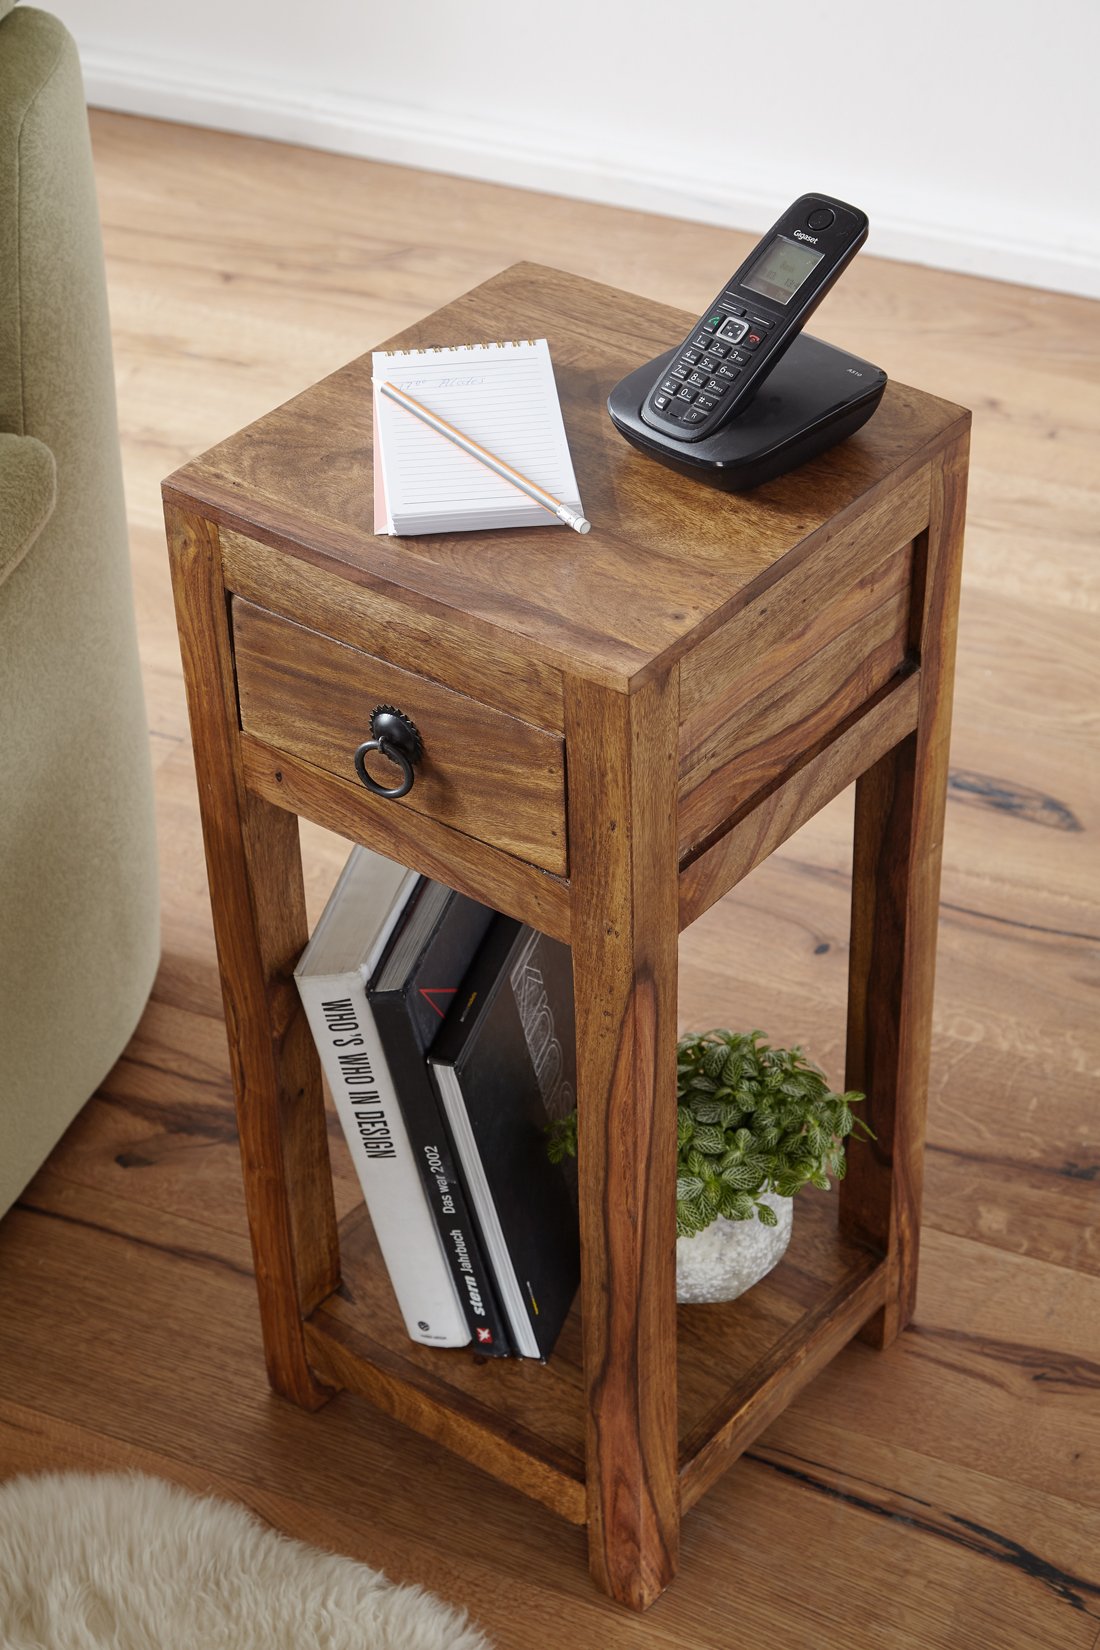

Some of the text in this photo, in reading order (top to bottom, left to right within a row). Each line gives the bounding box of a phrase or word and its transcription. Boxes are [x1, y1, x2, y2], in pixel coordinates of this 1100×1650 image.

[793, 229, 819, 245] Gigaset
[712, 343, 720, 351] 2
[730, 351, 739, 359] 3
[701, 358, 709, 366] 5
[720, 366, 728, 374] 6
[690, 373, 699, 381] 8
[708, 380, 716, 388] 9
[680, 388, 688, 396] 0
[321, 998, 397, 1159] WHO'S WHO IN DESIGN
[424, 1145, 486, 1317] stern Jahrbuch Das war 2002
